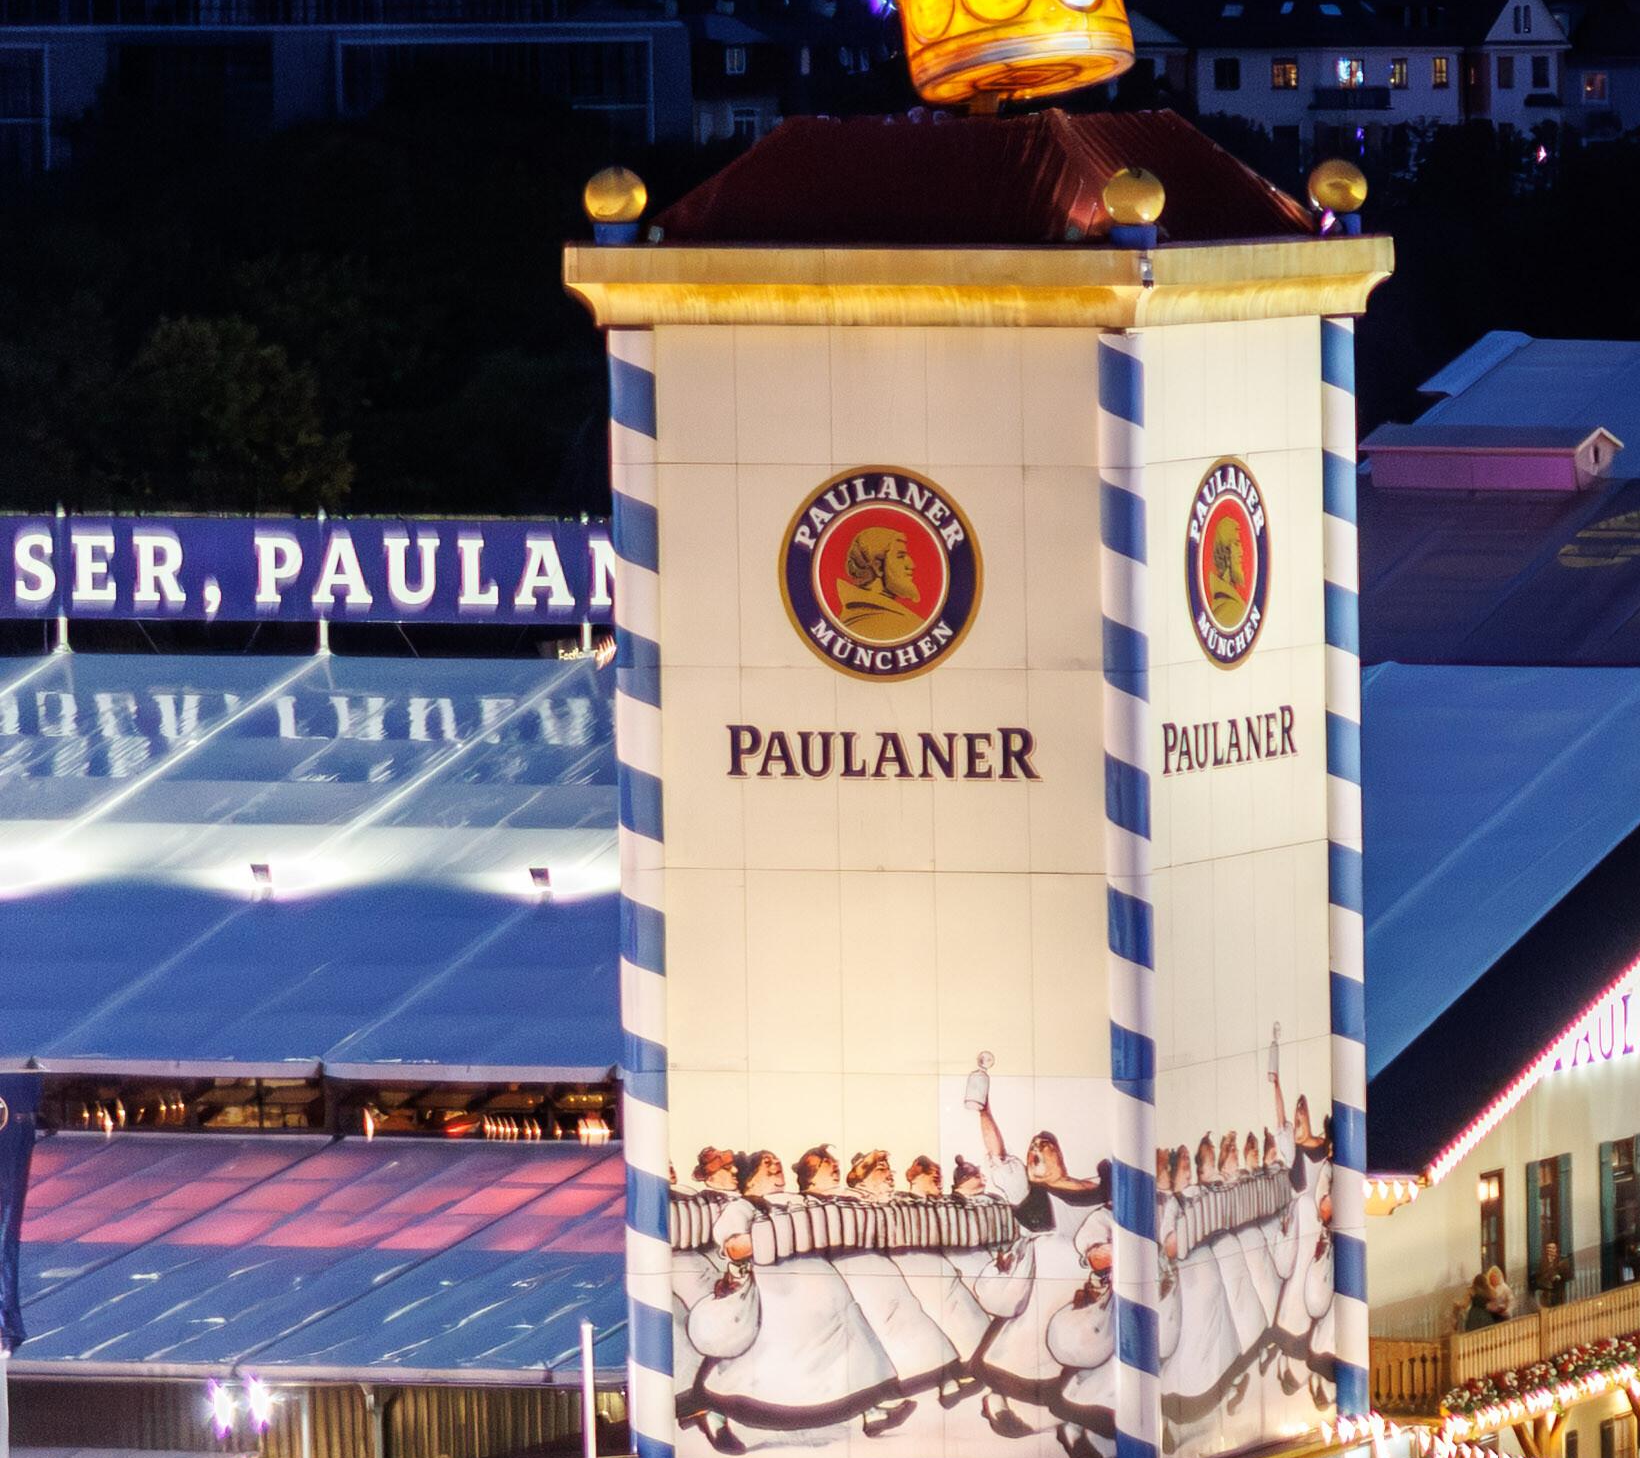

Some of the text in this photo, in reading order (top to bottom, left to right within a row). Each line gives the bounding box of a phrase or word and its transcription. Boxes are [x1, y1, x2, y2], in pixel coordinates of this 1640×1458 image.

[794, 475, 967, 551] PAULANER
[1188, 465, 1266, 544] PAULANER
[14, 534, 219, 613] SER,
[809, 619, 957, 671] MÜNCHEN
[1196, 604, 1263, 659] MÜNCHEN
[727, 724, 1043, 782] PAULANER
[1161, 705, 1299, 778] PAULANER
